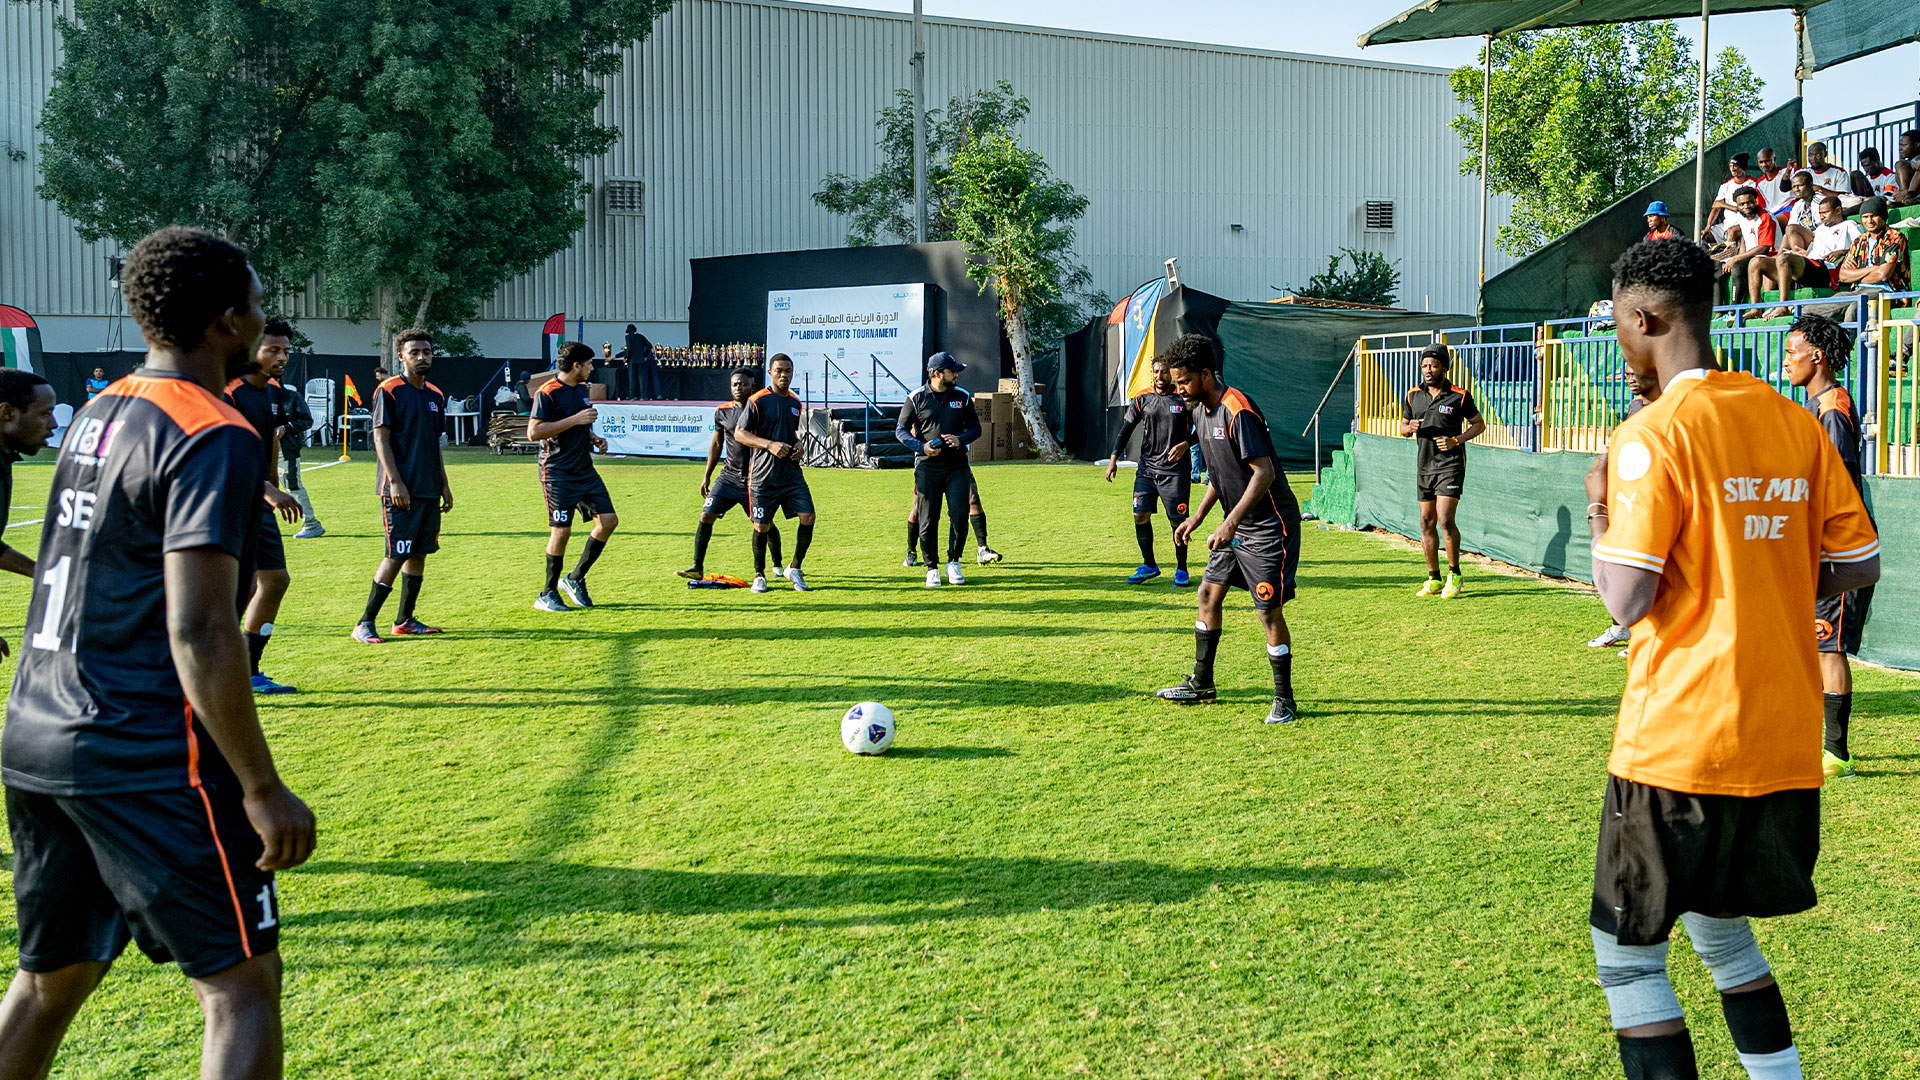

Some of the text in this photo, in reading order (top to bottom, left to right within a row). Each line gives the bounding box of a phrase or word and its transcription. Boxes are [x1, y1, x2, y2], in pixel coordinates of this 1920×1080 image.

[790, 312, 899, 327] الدورة الرياضية العمالية السابعة
[799, 330, 823, 340] LABOUR
[825, 329, 851, 339] SPORTS
[853, 328, 898, 339] TOURNAMENT
[602, 425, 626, 433] SPORTS
[655, 424, 671, 433] SPORTS
[673, 425, 703, 433] TOURNAMENT
[553, 509, 568, 522] 05
[396, 540, 412, 554] 07
